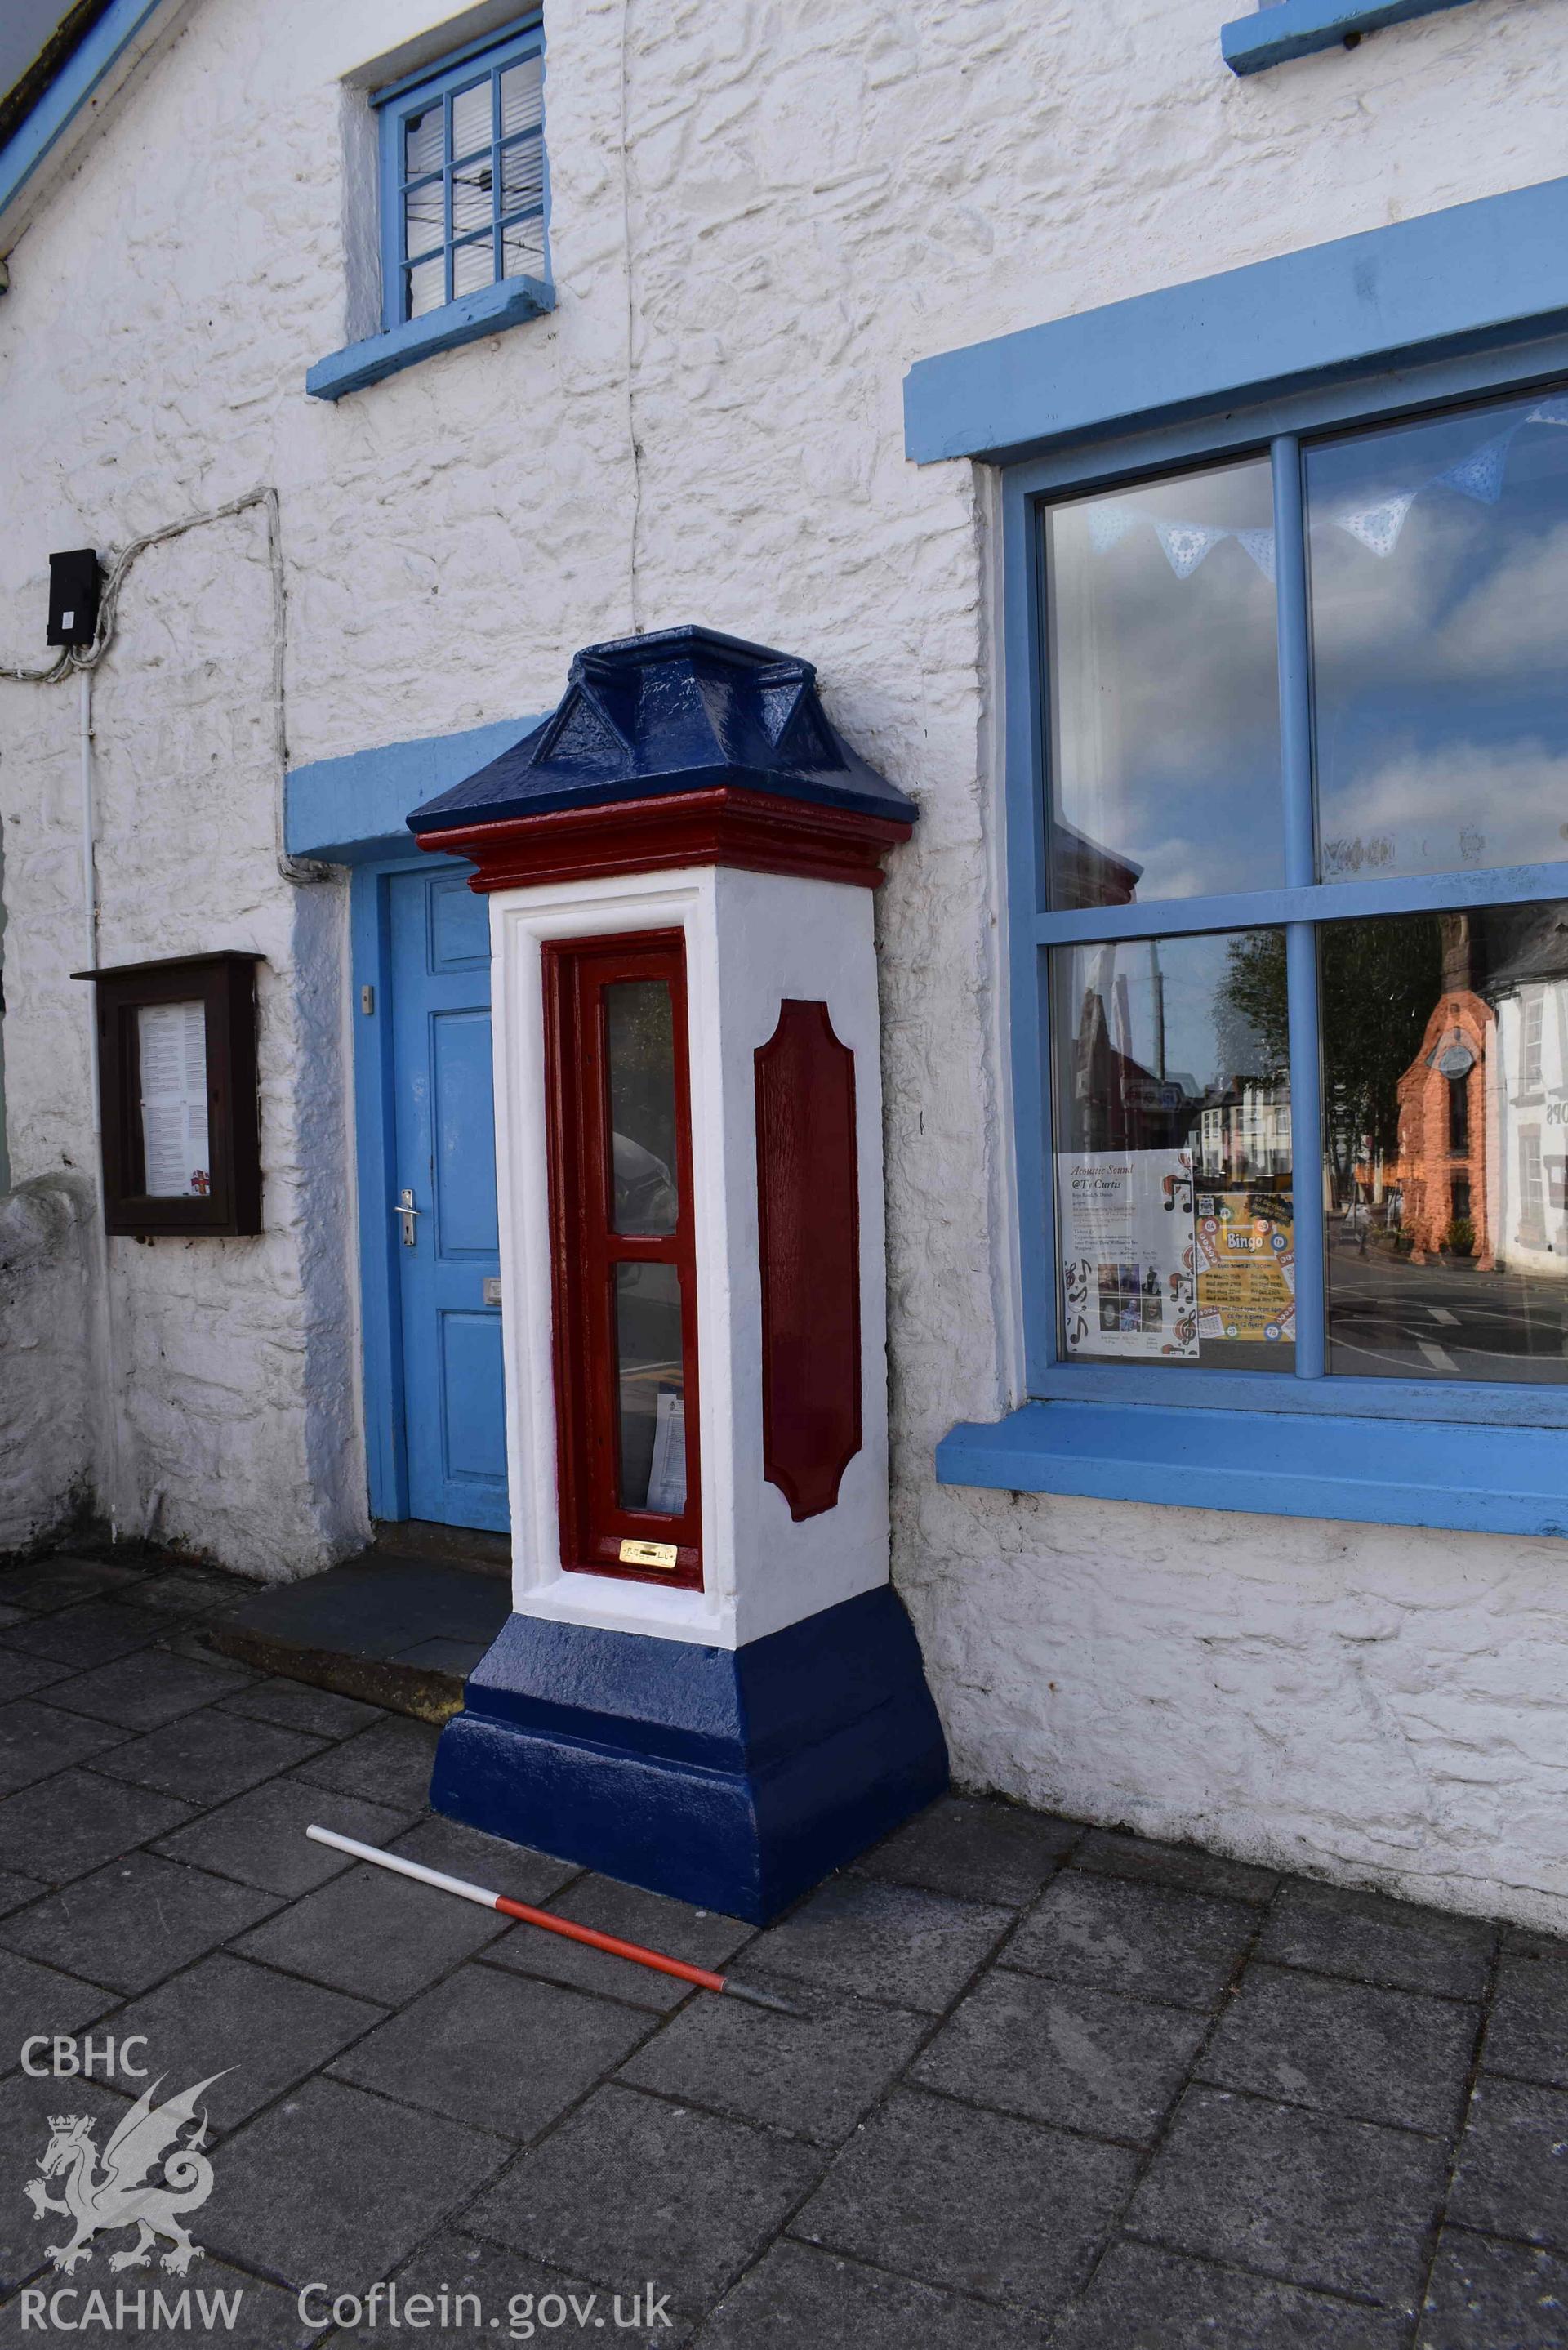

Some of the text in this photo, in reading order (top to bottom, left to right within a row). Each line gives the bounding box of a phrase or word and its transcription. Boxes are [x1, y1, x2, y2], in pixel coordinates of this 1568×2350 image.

[1071, 1164, 1134, 1175] Acoustic Sound
[1094, 1179, 1121, 1189] Curtis
[1227, 1233, 1264, 1253] Bingo
